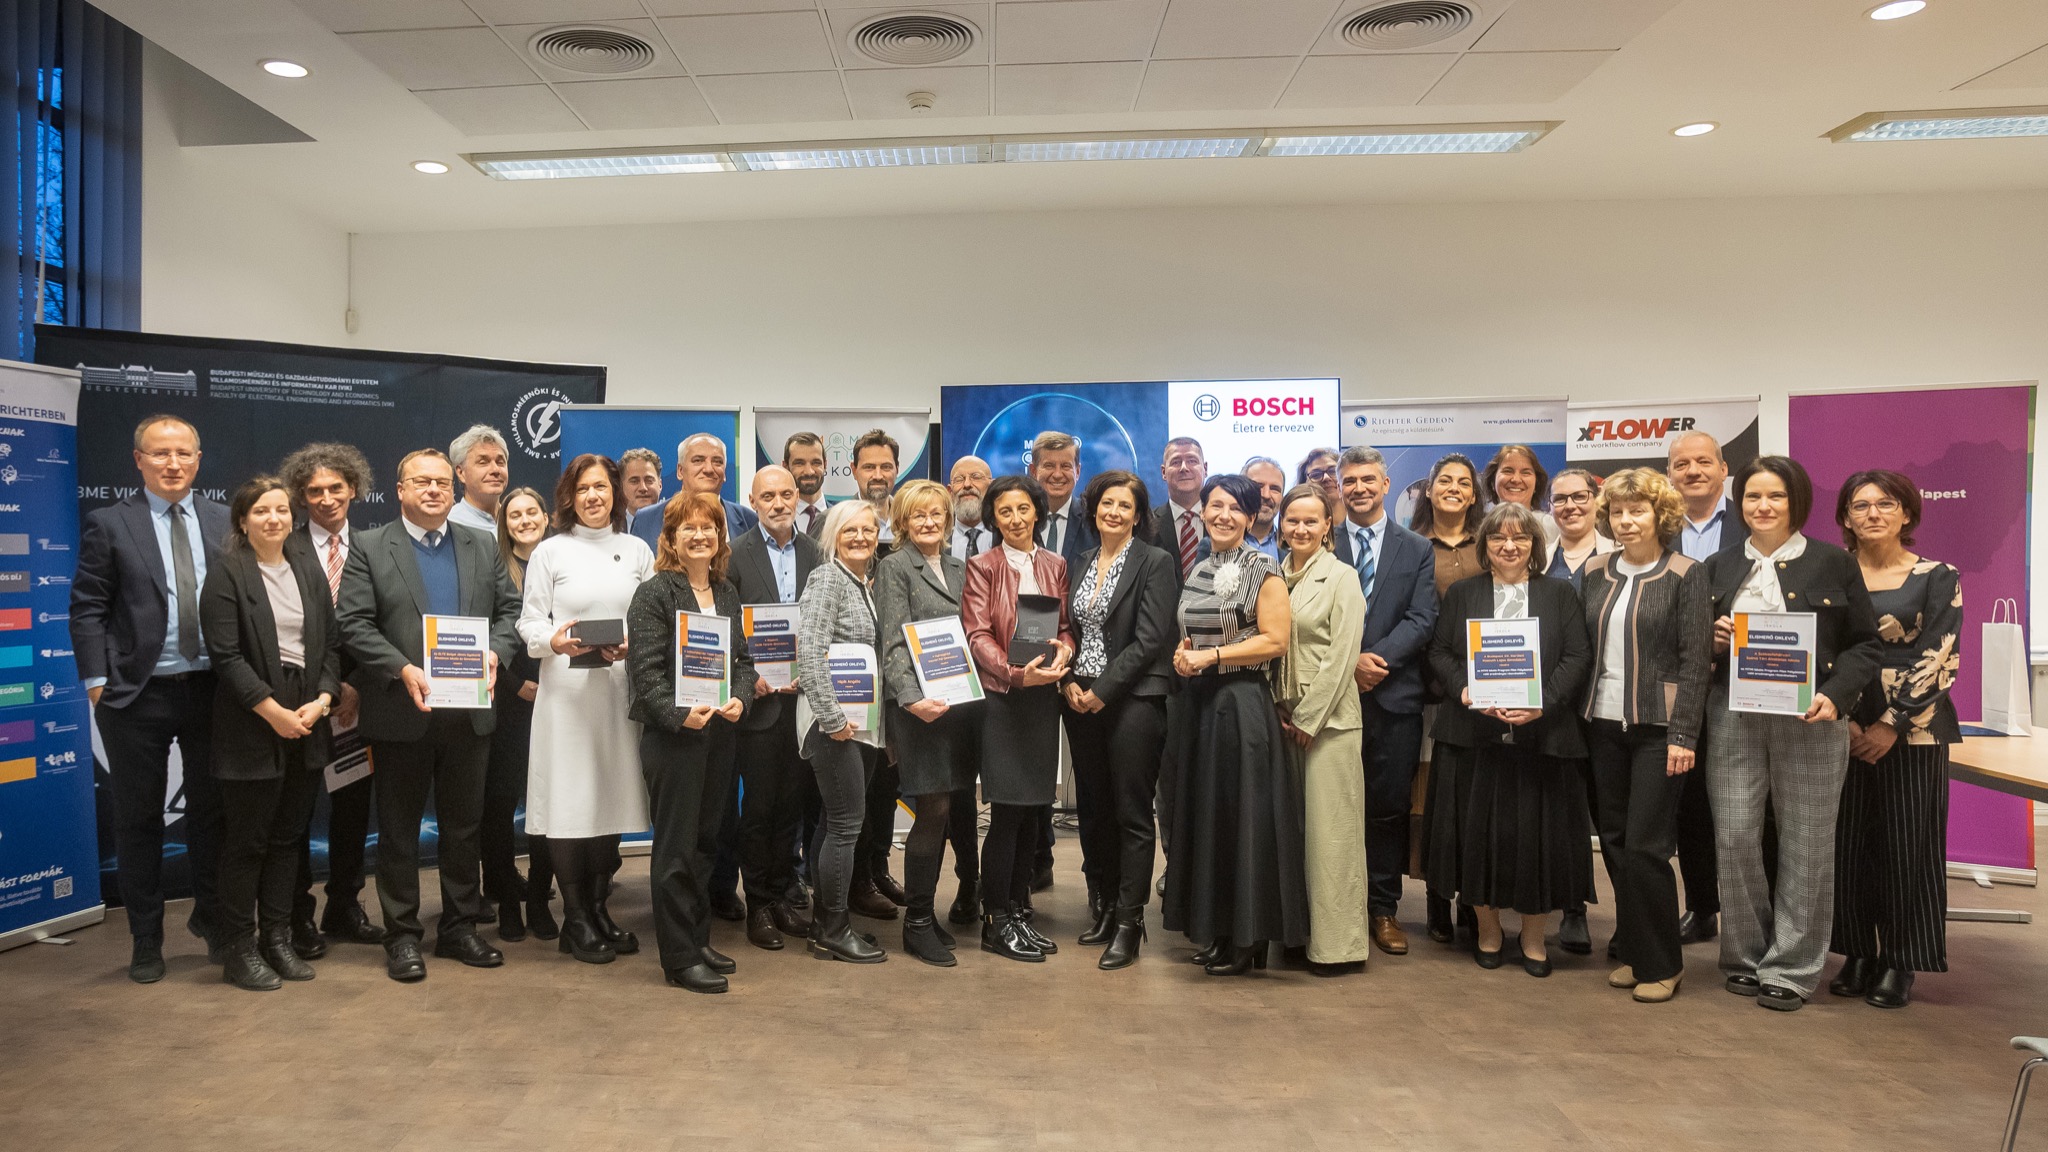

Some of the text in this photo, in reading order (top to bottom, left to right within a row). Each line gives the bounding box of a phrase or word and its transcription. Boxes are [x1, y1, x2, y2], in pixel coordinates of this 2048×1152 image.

[281, 382, 324, 390] INFORMATIKAI
[292, 388, 330, 397] TECHNOLOGY
[0, 404, 66, 421] RICHTERBEN
[1233, 397, 1314, 416] BOSCH
[524, 447, 540, 459] BME
[552, 387, 560, 397] ÉS
[1233, 421, 1314, 432] Életre tervezve
[202, 489, 226, 500] VIK
[20, 865, 64, 884] FORMÁK
